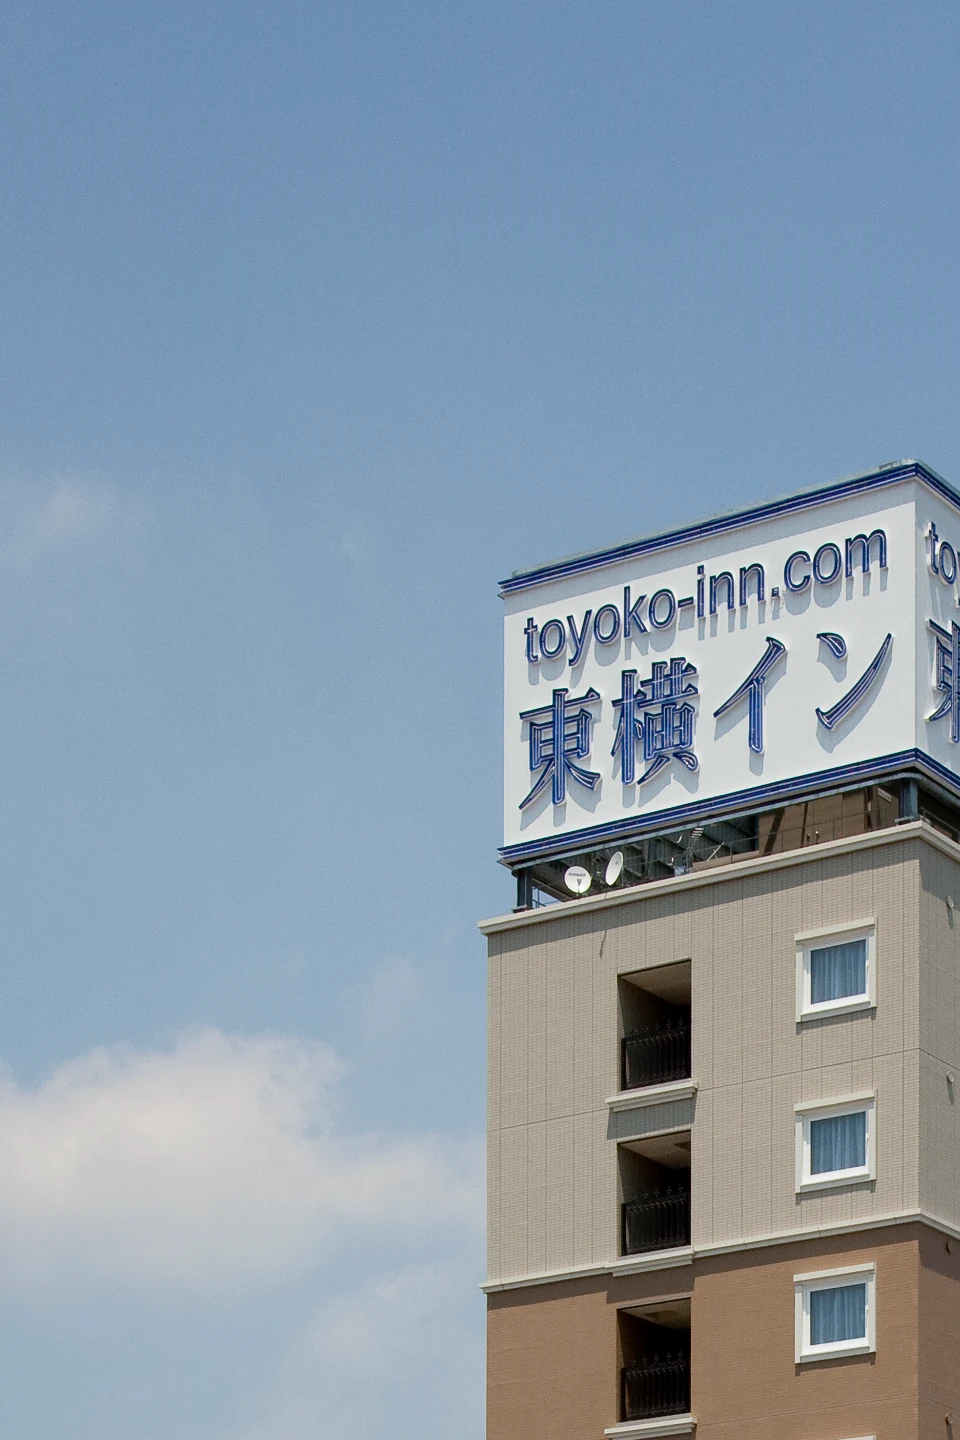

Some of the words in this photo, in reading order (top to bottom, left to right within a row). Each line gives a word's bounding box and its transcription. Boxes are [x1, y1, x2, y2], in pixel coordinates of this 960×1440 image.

[524, 528, 888, 667] toyoko-inn.com
[518, 632, 893, 810] 東横イン
